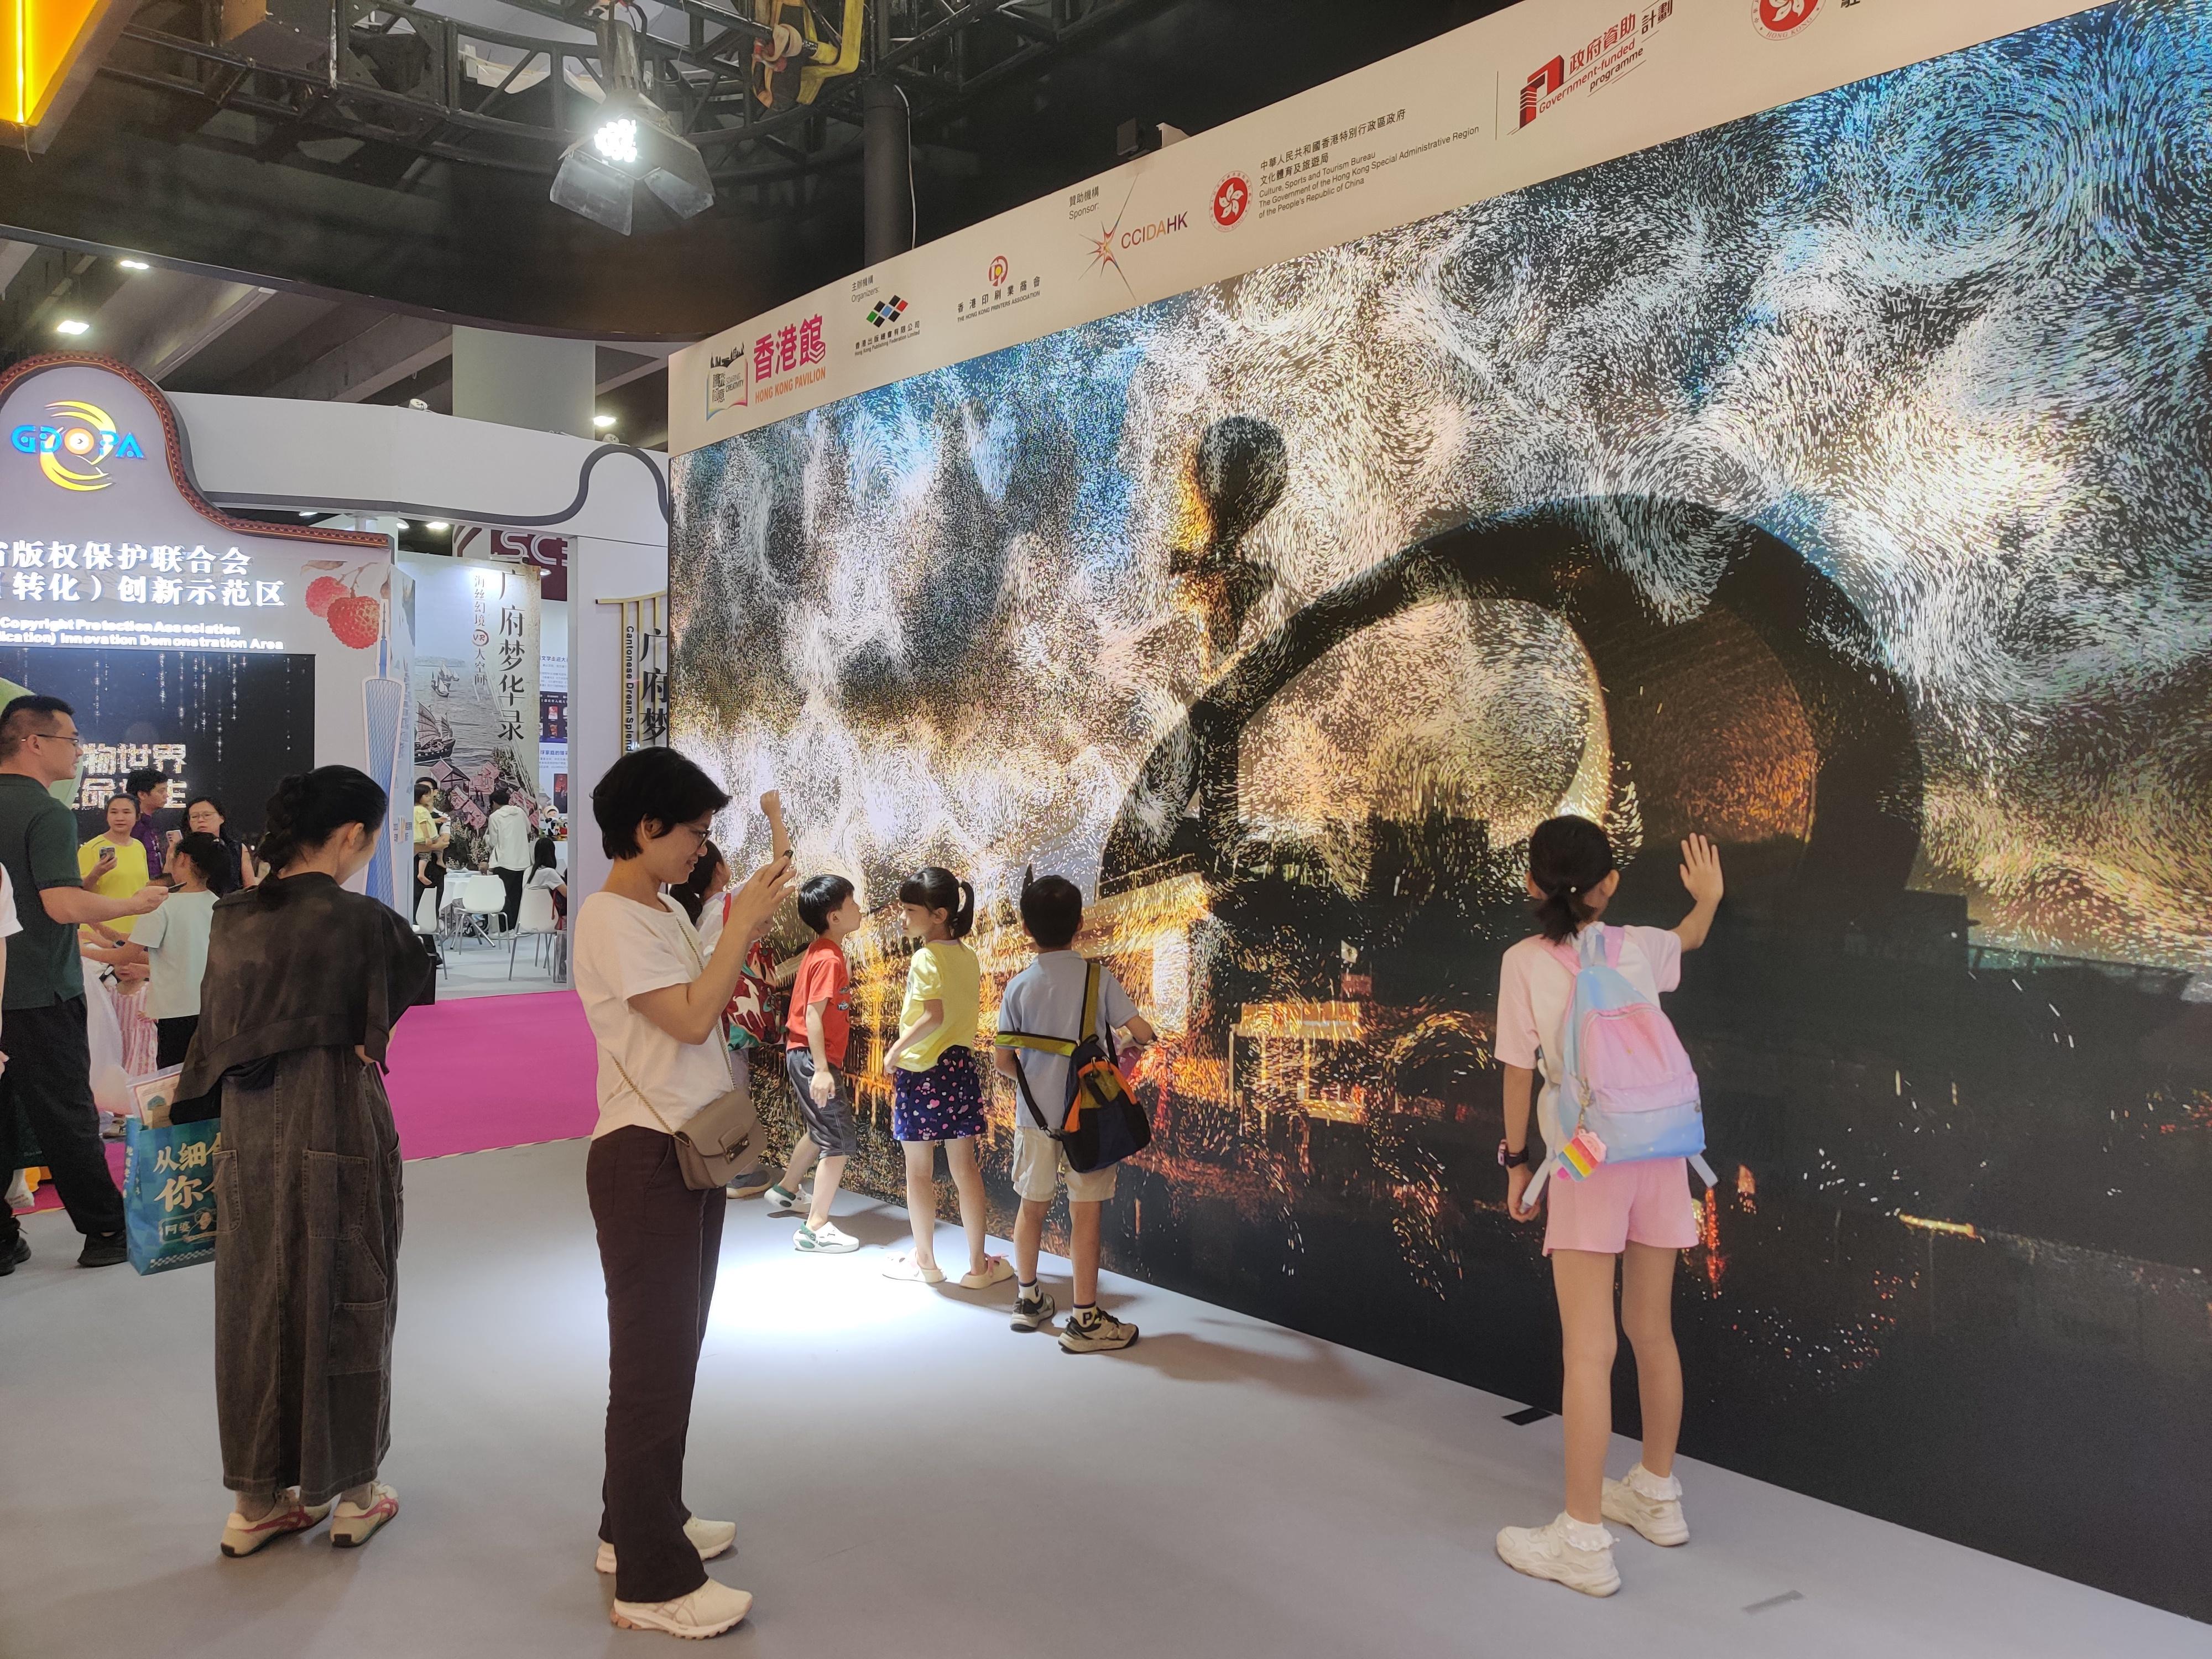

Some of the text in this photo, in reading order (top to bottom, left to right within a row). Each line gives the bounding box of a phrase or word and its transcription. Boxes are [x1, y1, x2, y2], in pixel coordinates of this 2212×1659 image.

[1540, 38, 1635, 113] Government-funded
[1589, 48, 1644, 92] programme
[1260, 109, 1406, 171] 中華人民共和國香港特別行政區政府
[1259, 199, 1270, 208] The
[1272, 185, 1311, 204] Government
[1320, 178, 1331, 187] the
[1333, 170, 1350, 183] Hong
[1352, 164, 1370, 176] Kong
[1371, 153, 1397, 170] Special
[1399, 136, 1451, 160] Administrative
[1452, 126, 1479, 142] Region
[1259, 152, 1375, 198] Culture, Sports and Tourism Bureau
[1260, 153, 1329, 187] 文化體育及旅遊局
[1068, 202, 1099, 221] Sponsor:
[1259, 210, 1265, 219] of
[1266, 206, 1276, 216] the
[1278, 197, 1305, 212] People's
[1306, 187, 1335, 203] Republic
[1345, 178, 1364, 190] China
[1121, 211, 1188, 249] CCIDAHK
[851, 287, 880, 302] Organizers:
[958, 276, 1040, 313] 香港印刷業商會
[966, 311, 978, 320] HONG
[978, 307, 990, 316] KONG
[991, 300, 1011, 311] PRINTERS
[1011, 290, 1040, 305] ASSOCIATION
[754, 314, 826, 383] 香港館
[907, 330, 920, 338] Limited
[755, 367, 826, 404] HONG KONG PAVILION
[0, 571, 285, 607] 转化）创新示范区
[0, 617, 241, 635] Copyright Protection Association
[60, 632, 138, 645] Innovation
[139, 634, 247, 649] Demonstration
[249, 638, 284, 650] Area
[498, 569, 525, 741] 广府梦华录
[624, 625, 634, 753] Cantonese Dream Splend
[154, 1175, 215, 1212] 你
